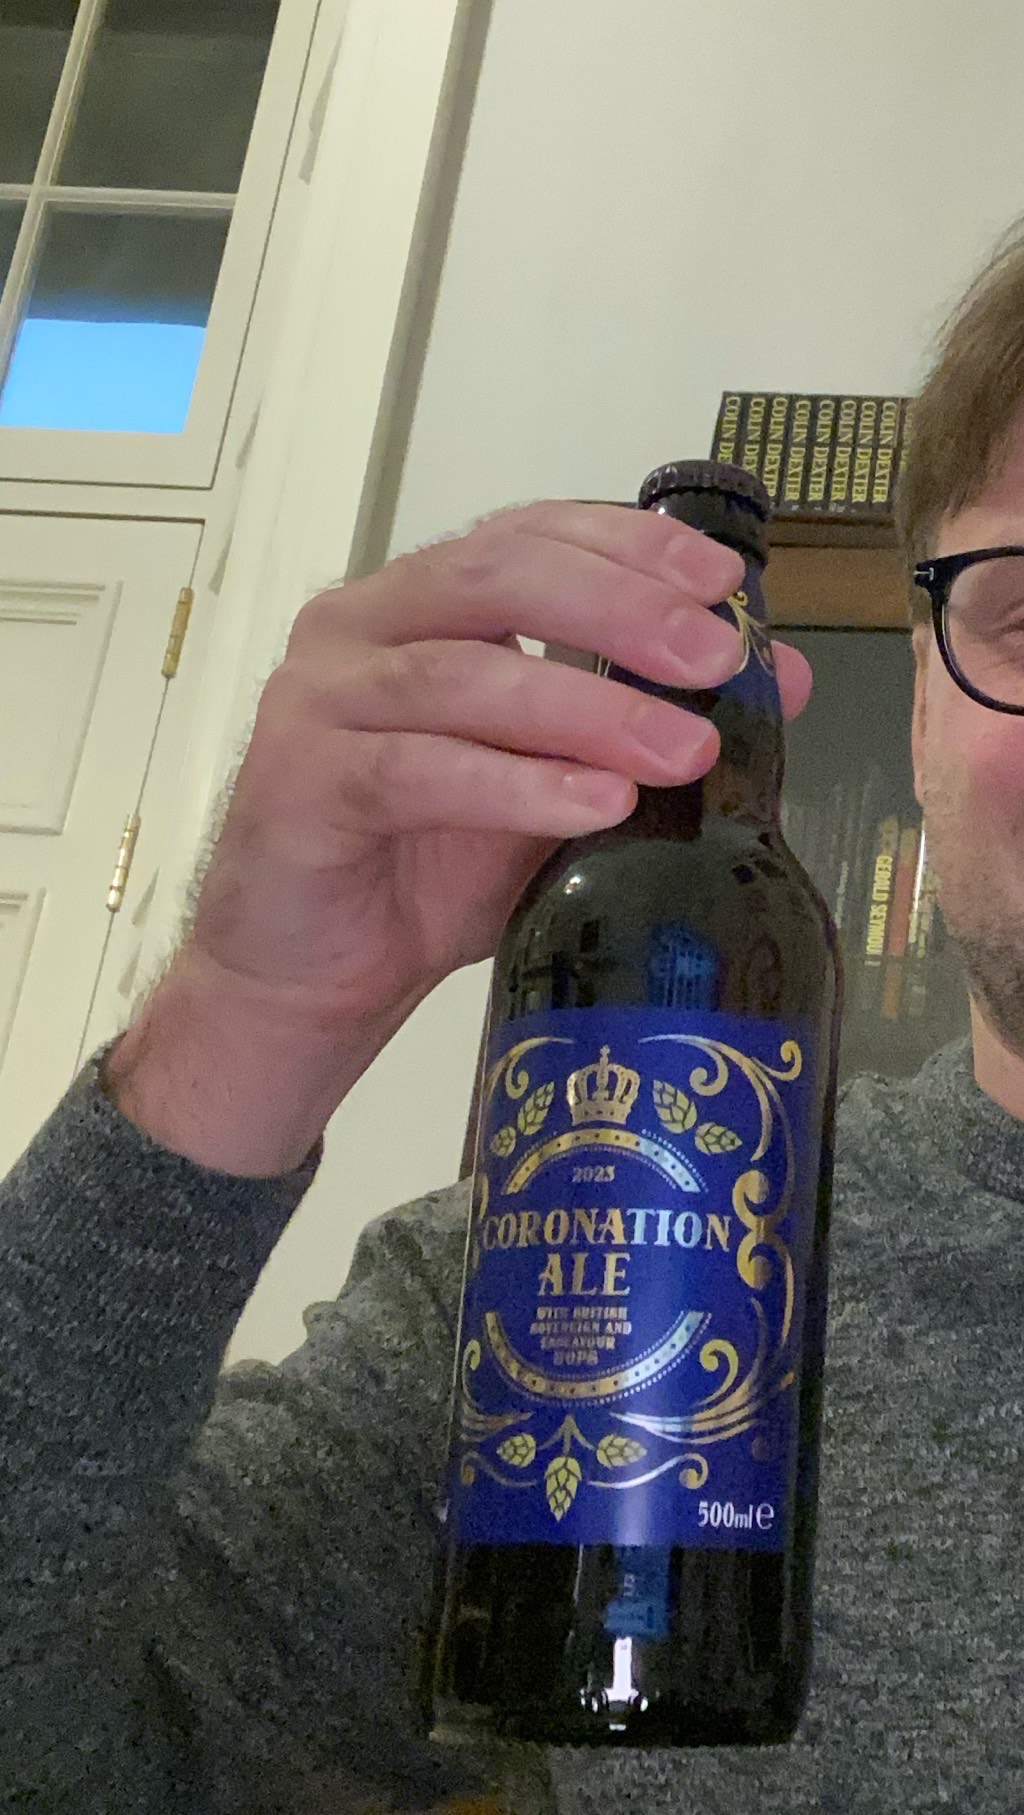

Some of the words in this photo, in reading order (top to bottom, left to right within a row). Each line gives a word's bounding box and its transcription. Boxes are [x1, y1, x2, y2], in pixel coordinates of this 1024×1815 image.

[722, 396, 740, 438] COLIN
[748, 398, 766, 440] COLIN
[769, 396, 788, 440] COLIN
[792, 400, 811, 443] COLIN
[816, 400, 835, 442] COLIN
[838, 400, 857, 442] COLIN
[859, 401, 877, 444] COLIN
[880, 401, 898, 445] COLIN
[785, 447, 806, 501] DEXTER
[808, 447, 829, 501] DEXTER
[830, 447, 852, 501] DEXTER
[852, 448, 872, 503] DEXTER
[872, 448, 893, 504] DEXTER
[871, 855, 893, 901] GERALD
[482, 1208, 731, 1252] CORONATION
[537, 1252, 631, 1297] ALE
[605, 1321, 632, 1335] AND
[697, 1501, 753, 1529] 500ml
